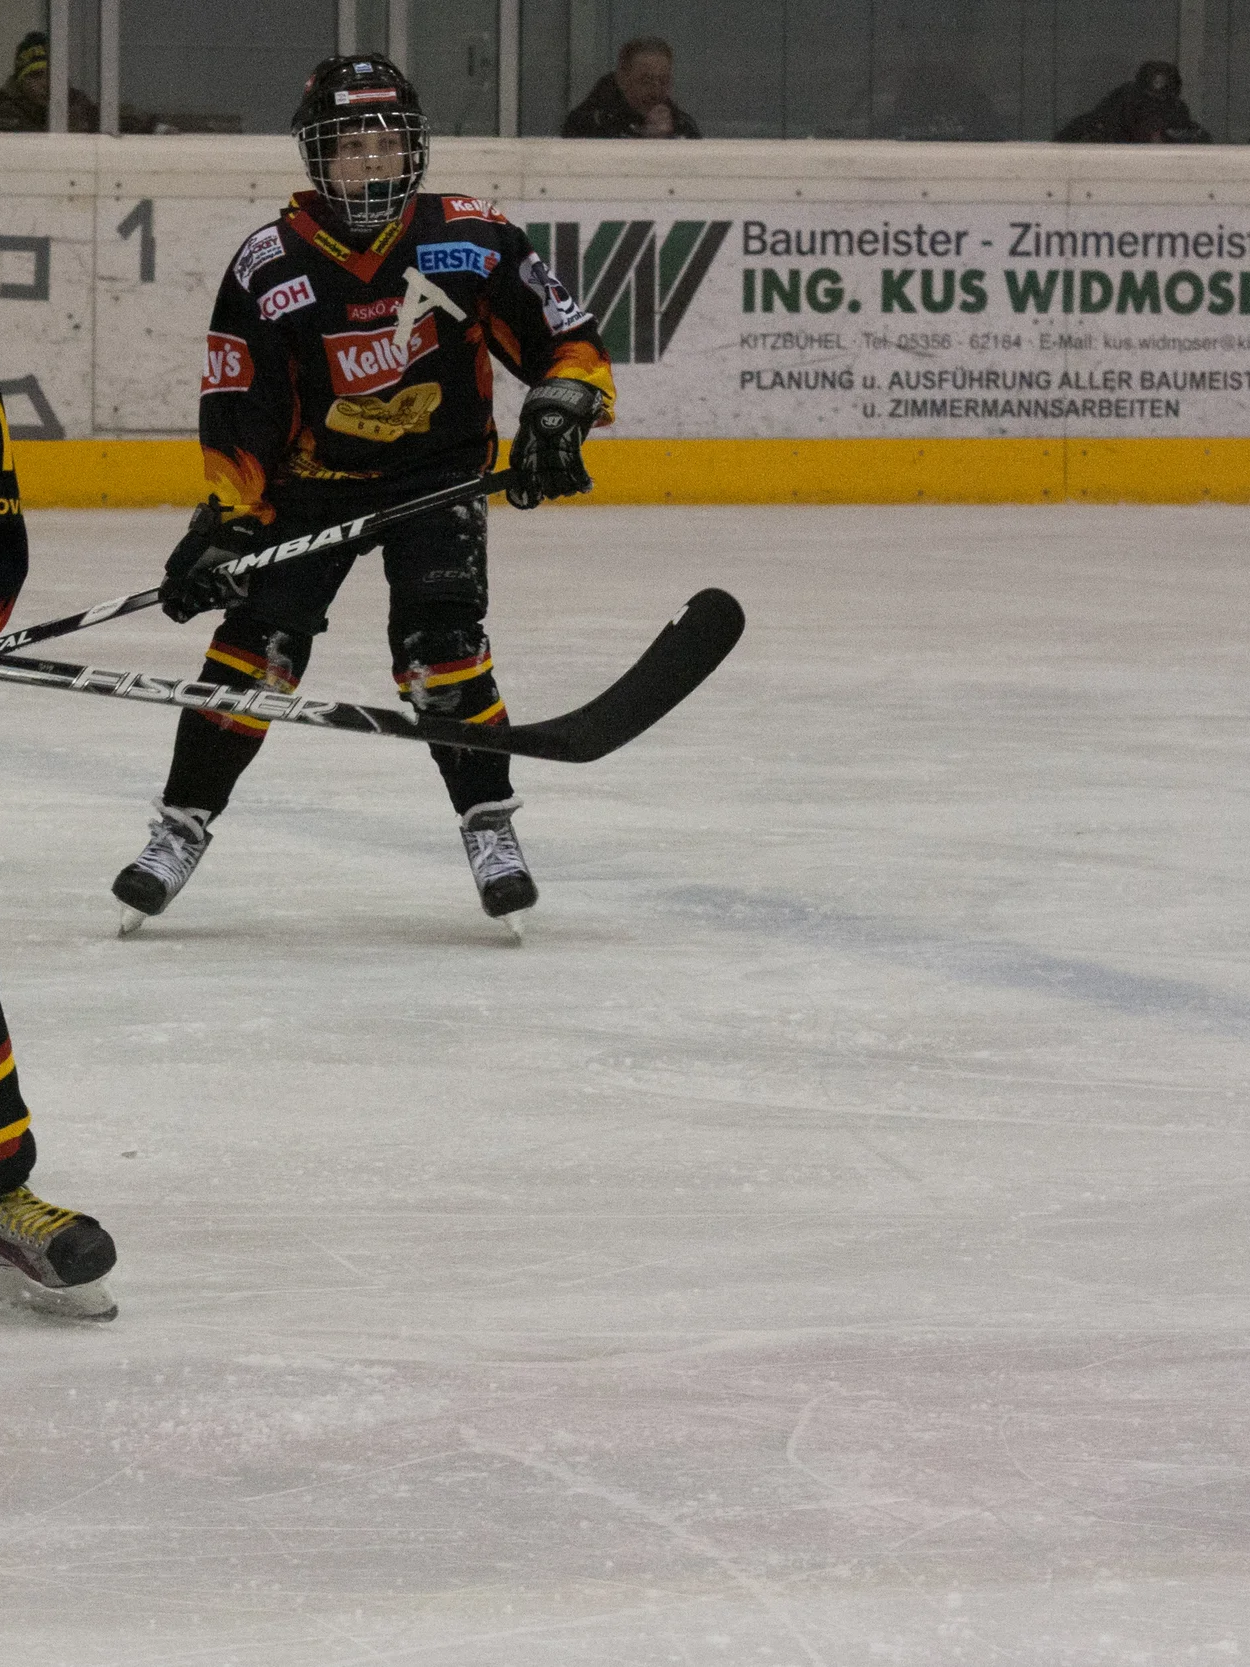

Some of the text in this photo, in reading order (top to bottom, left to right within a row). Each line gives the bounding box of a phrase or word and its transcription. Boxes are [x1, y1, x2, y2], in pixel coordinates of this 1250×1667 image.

[742, 220, 968, 257] Baumeister
[1008, 222, 1250, 258] Zimmermeis
[419, 248, 483, 272] ERSTE
[742, 268, 861, 314] ING.
[881, 269, 988, 314] KUS
[739, 370, 854, 390] PLANUNG
[862, 376, 881, 390] u.
[888, 367, 1051, 390] AUSFÜHRUNG
[1057, 370, 1132, 390] ALLER
[862, 399, 1180, 419] u. ZIMMERMANNSARBEITEN
[70, 665, 338, 726] FISCHER
